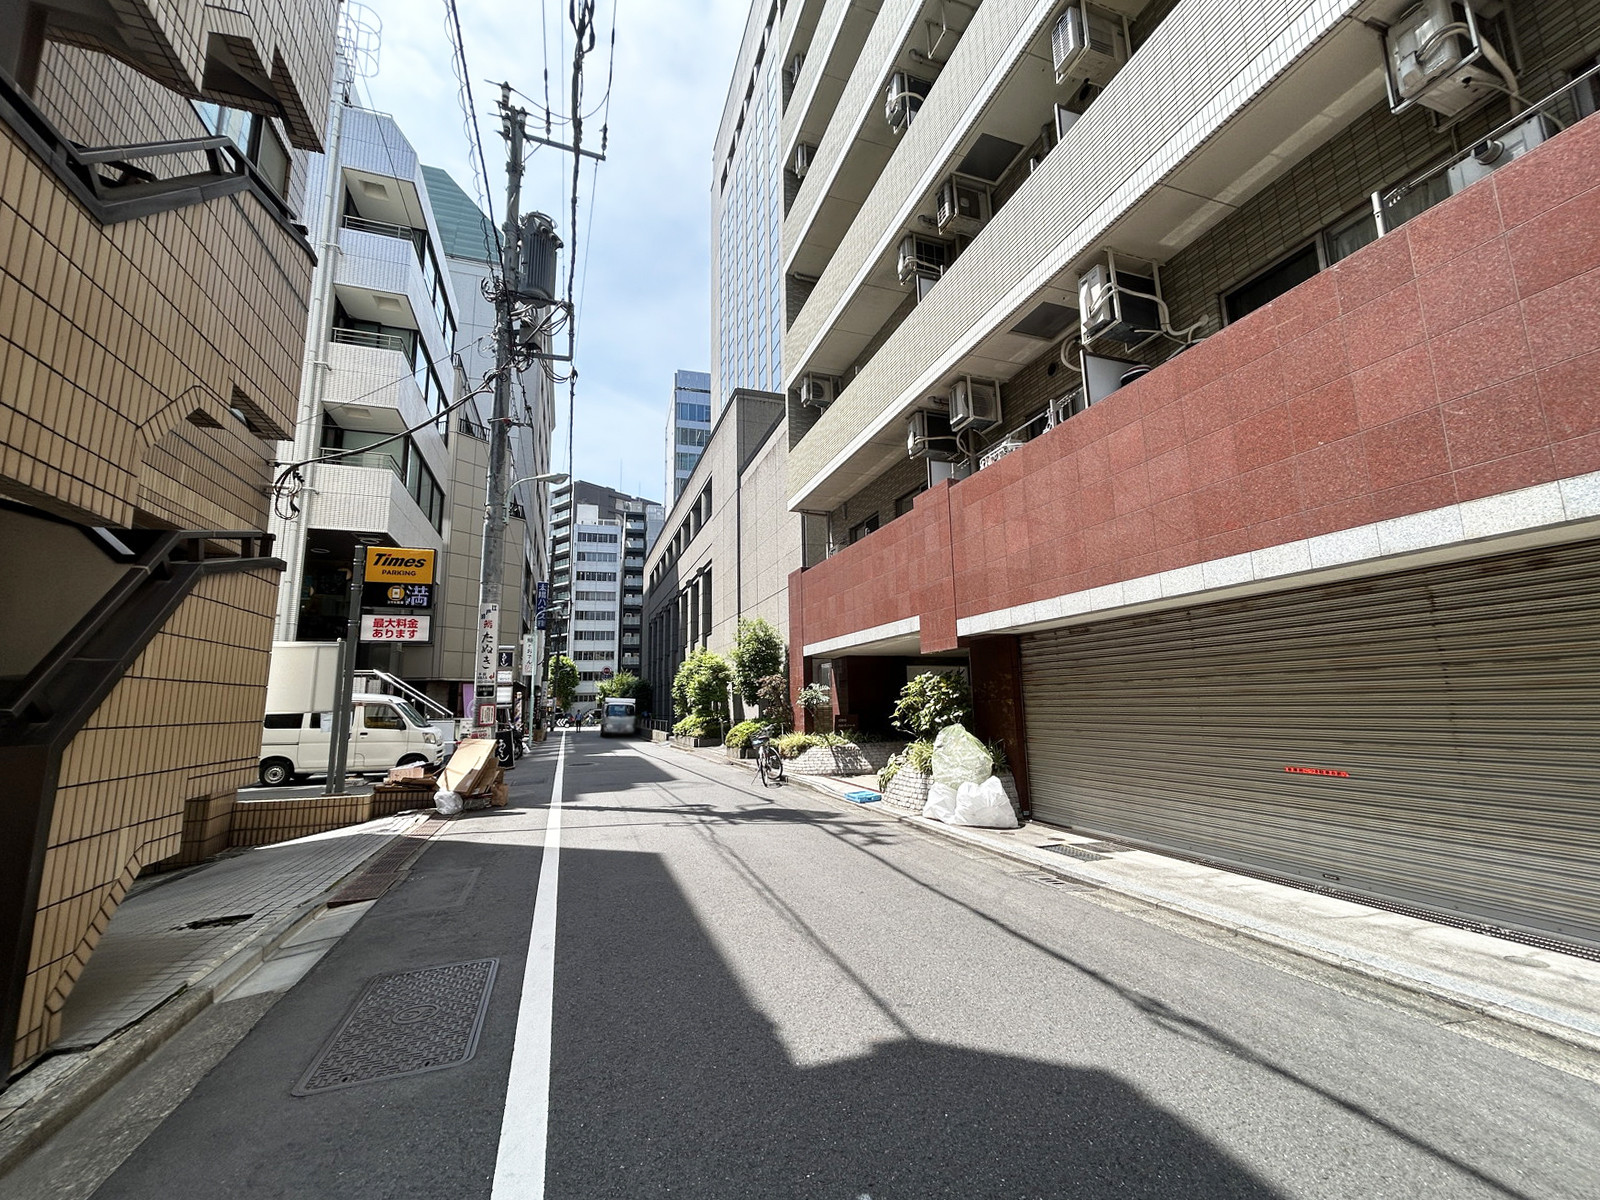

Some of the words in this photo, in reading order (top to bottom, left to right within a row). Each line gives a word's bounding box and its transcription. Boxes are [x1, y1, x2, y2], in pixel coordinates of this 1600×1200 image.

[373, 553, 427, 568] Times
[381, 569, 417, 577] PARKING
[372, 618, 419, 629] 最大料金
[372, 629, 418, 639] あります
